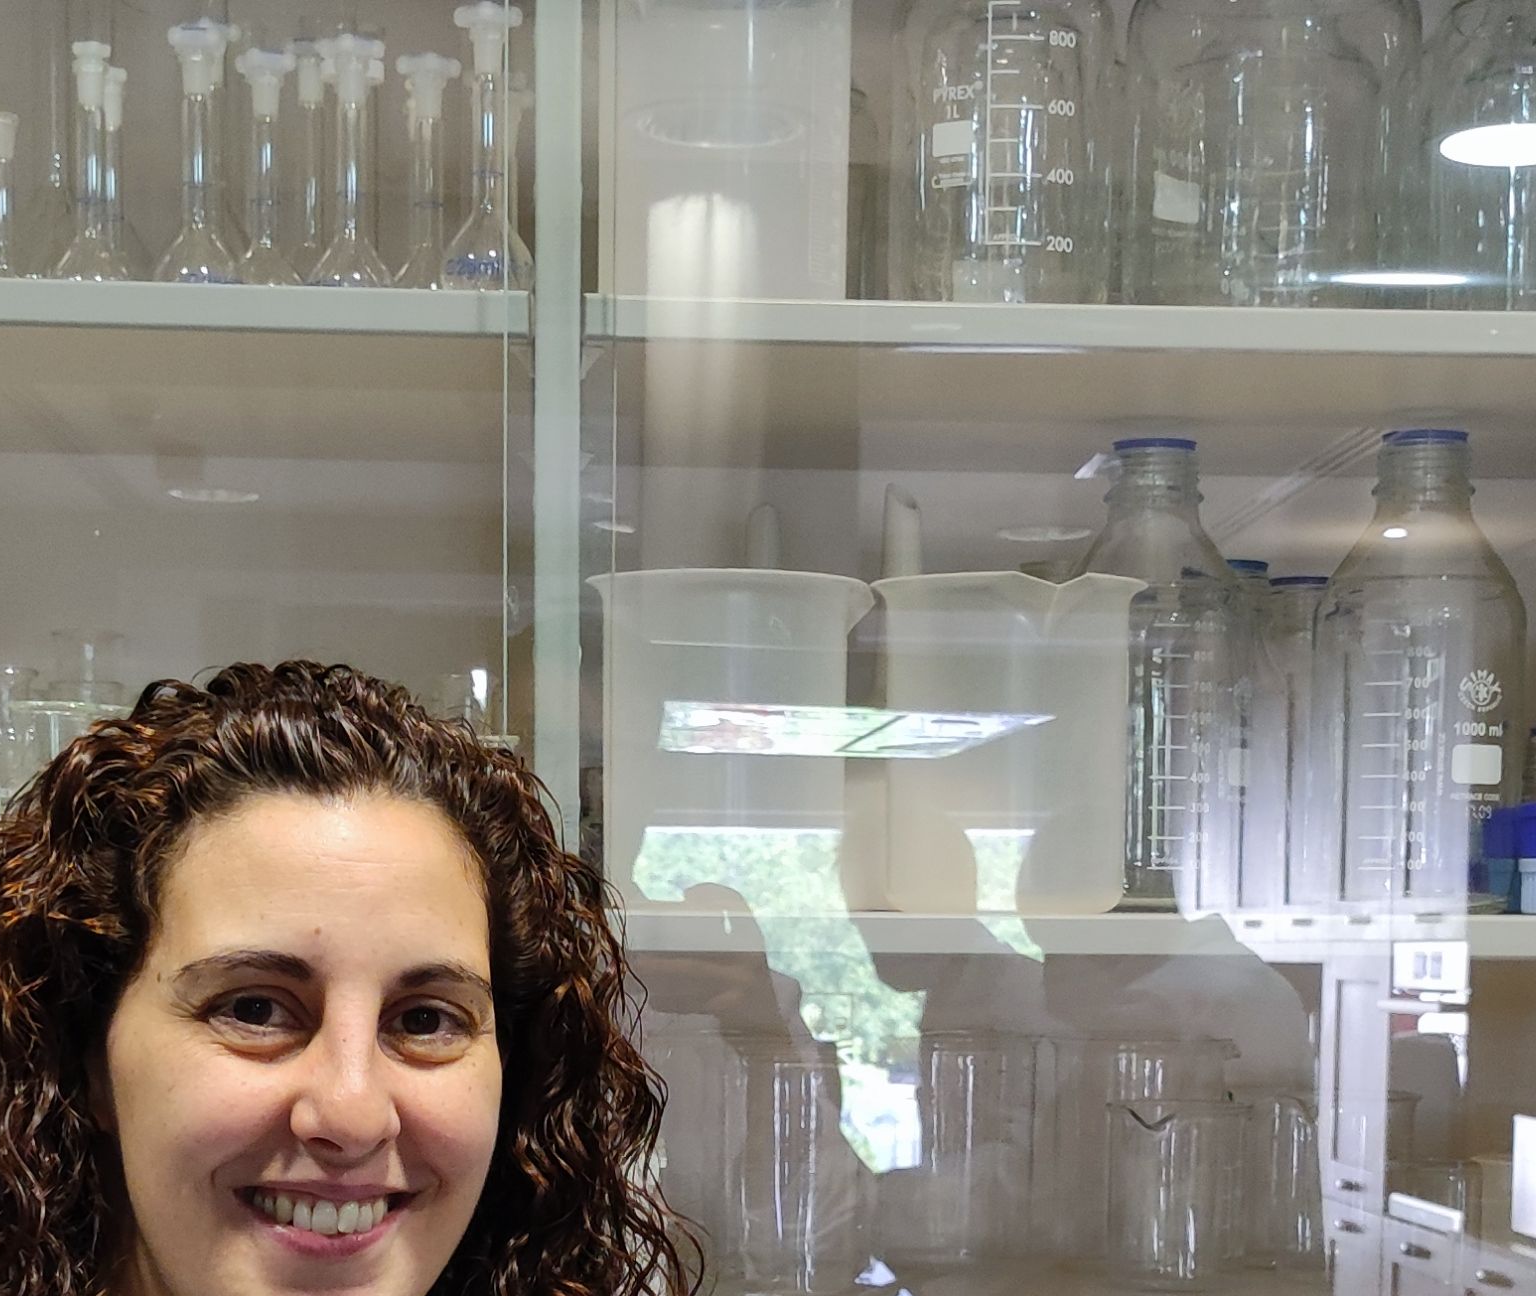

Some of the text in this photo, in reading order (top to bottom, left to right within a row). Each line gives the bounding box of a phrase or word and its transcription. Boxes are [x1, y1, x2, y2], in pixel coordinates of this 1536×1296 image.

[1049, 30, 1076, 48] 800
[1048, 100, 1075, 116] 600
[1046, 169, 1074, 184] 400
[1046, 236, 1073, 253] 200
[1406, 678, 1429, 689] 700
[1454, 721, 1503, 737] 1000 ml
